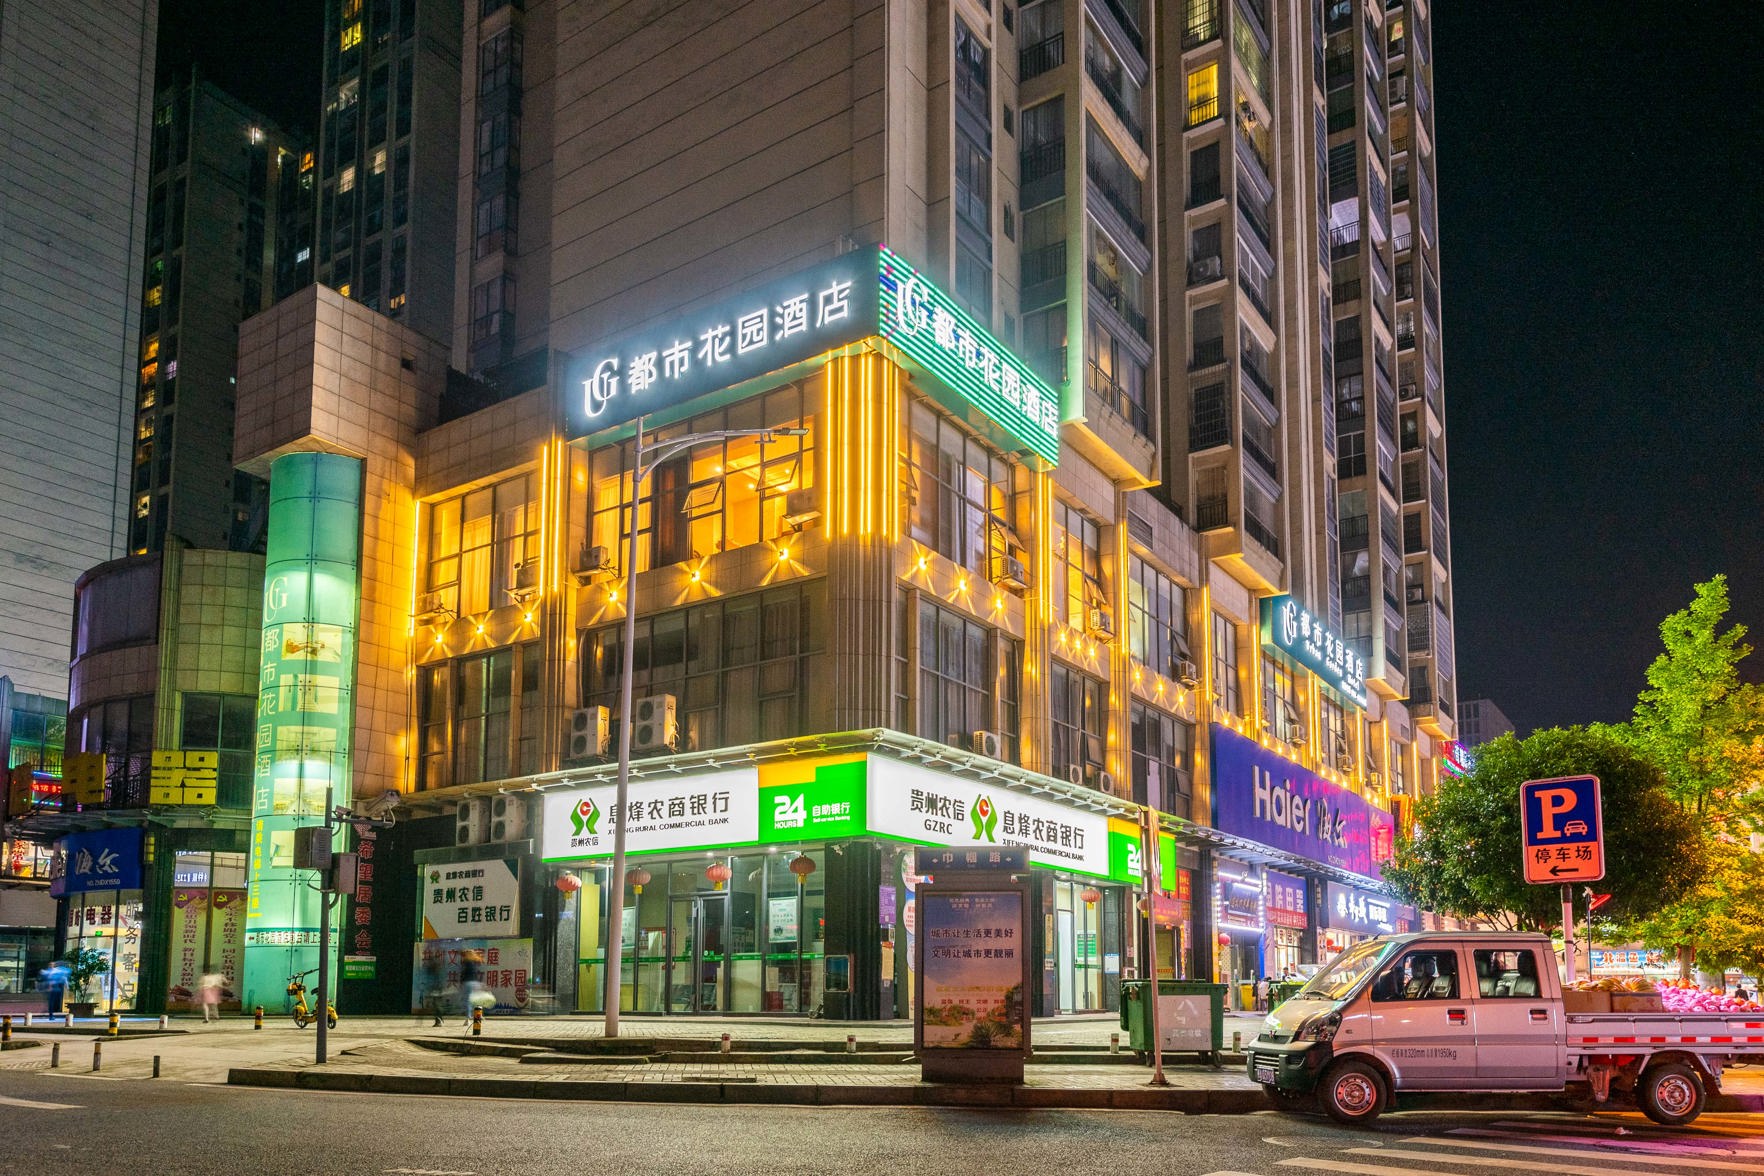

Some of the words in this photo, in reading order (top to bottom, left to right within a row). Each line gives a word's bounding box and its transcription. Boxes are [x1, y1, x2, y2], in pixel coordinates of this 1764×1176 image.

[627, 280, 852, 396] 都市花园酒店
[932, 304, 1059, 440] 都市花园酒店
[1301, 609, 1363, 683] 都市花园酒店
[256, 627, 281, 812] 都市花园酒店
[608, 790, 731, 825] 息烽农商银行
[773, 792, 807, 828] 24
[812, 801, 850, 817] 自助银行
[910, 788, 965, 822] 贵州农信
[1252, 764, 1311, 837] Haier
[1534, 787, 1578, 840] P
[607, 826, 635, 836] XING
[635, 824, 658, 833] RURAL
[658, 818, 707, 831] COMMERCIAL
[708, 817, 729, 826] BANK
[774, 820, 798, 830] HOURS
[924, 818, 953, 835] GZRC
[1002, 810, 1085, 850] 息烽农商银行
[570, 836, 600, 848] 贵州农信
[1534, 845, 1592, 865] 停车场
[355, 840, 375, 949] 希望居委会
[433, 886, 484, 904] 贵州农信
[457, 905, 512, 924] 百姓银行
[930, 928, 1014, 939] 城市让生活更美好
[932, 948, 1014, 959] 文明让城市更靓丽
[446, 968, 527, 989] 共明家园
